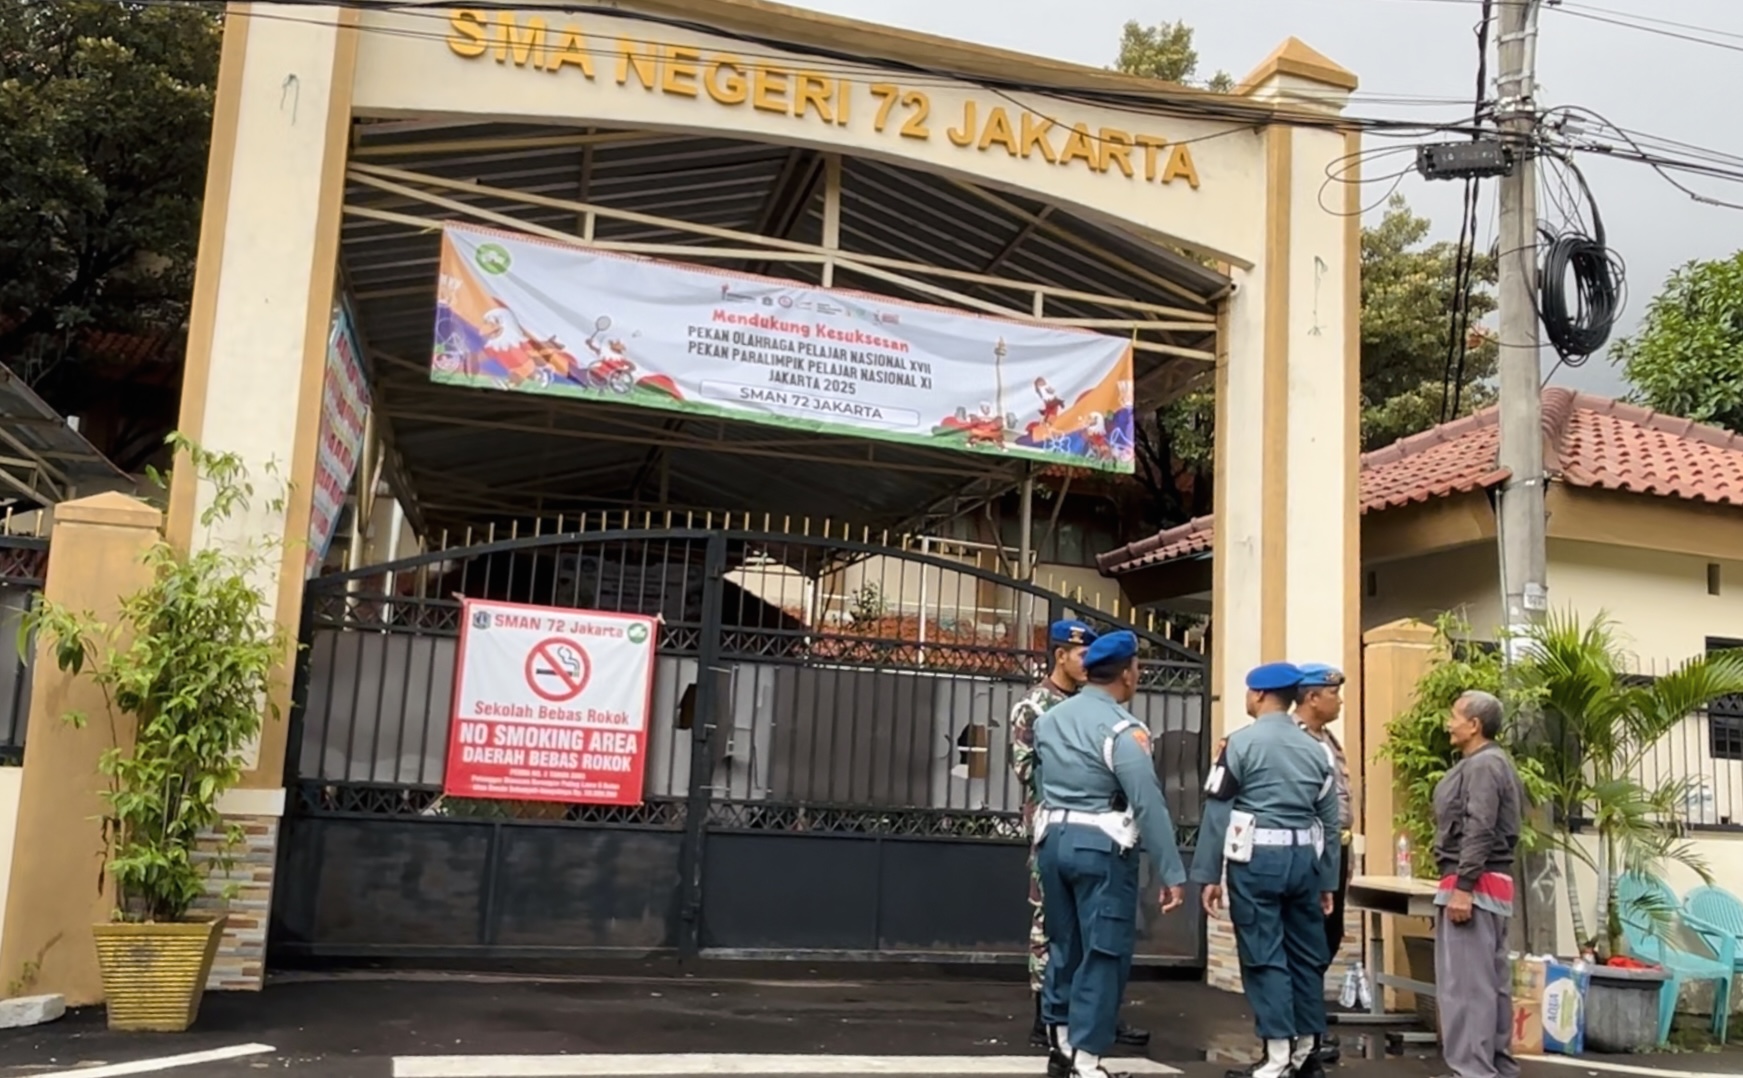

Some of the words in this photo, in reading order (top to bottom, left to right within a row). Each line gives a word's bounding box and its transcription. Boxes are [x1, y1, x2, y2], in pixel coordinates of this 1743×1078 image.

[447, 8, 594, 80] SMA
[616, 33, 851, 126] NEGERI
[870, 81, 930, 140] 72
[948, 100, 1200, 189] JAKARTA
[712, 309, 811, 337] Mendukung
[816, 323, 909, 352] Kesuksesan
[688, 326, 729, 342] PEKAN
[733, 331, 795, 352] OLAHRAGA
[798, 343, 848, 361] PELAJAR
[850, 349, 906, 369] NASIONAL
[911, 361, 931, 374] XVII
[688, 342, 729, 359] PEKAN
[732, 348, 804, 371] PARALIMPIK
[808, 361, 857, 379] PELAJAR
[860, 368, 917, 386] NASIONAL
[920, 377, 932, 389] XI
[769, 370, 820, 389] JAKARTA
[824, 379, 856, 394] 2025
[740, 387, 787, 404] SMAN
[792, 395, 810, 407] 72
[813, 399, 883, 420] JAKARTA
[494, 615, 540, 630] SMAN
[547, 619, 565, 632] 72
[570, 622, 623, 637] Jakarta
[475, 701, 533, 718] Sekolah
[539, 706, 582, 721] Bebas
[587, 710, 629, 724] Rokok
[460, 723, 487, 743] NO
[494, 726, 583, 749] SMOKING
[589, 733, 637, 754] AREA
[463, 747, 524, 764] DAERAH
[529, 753, 578, 768] BEBAS
[582, 756, 632, 771] ROKOK
